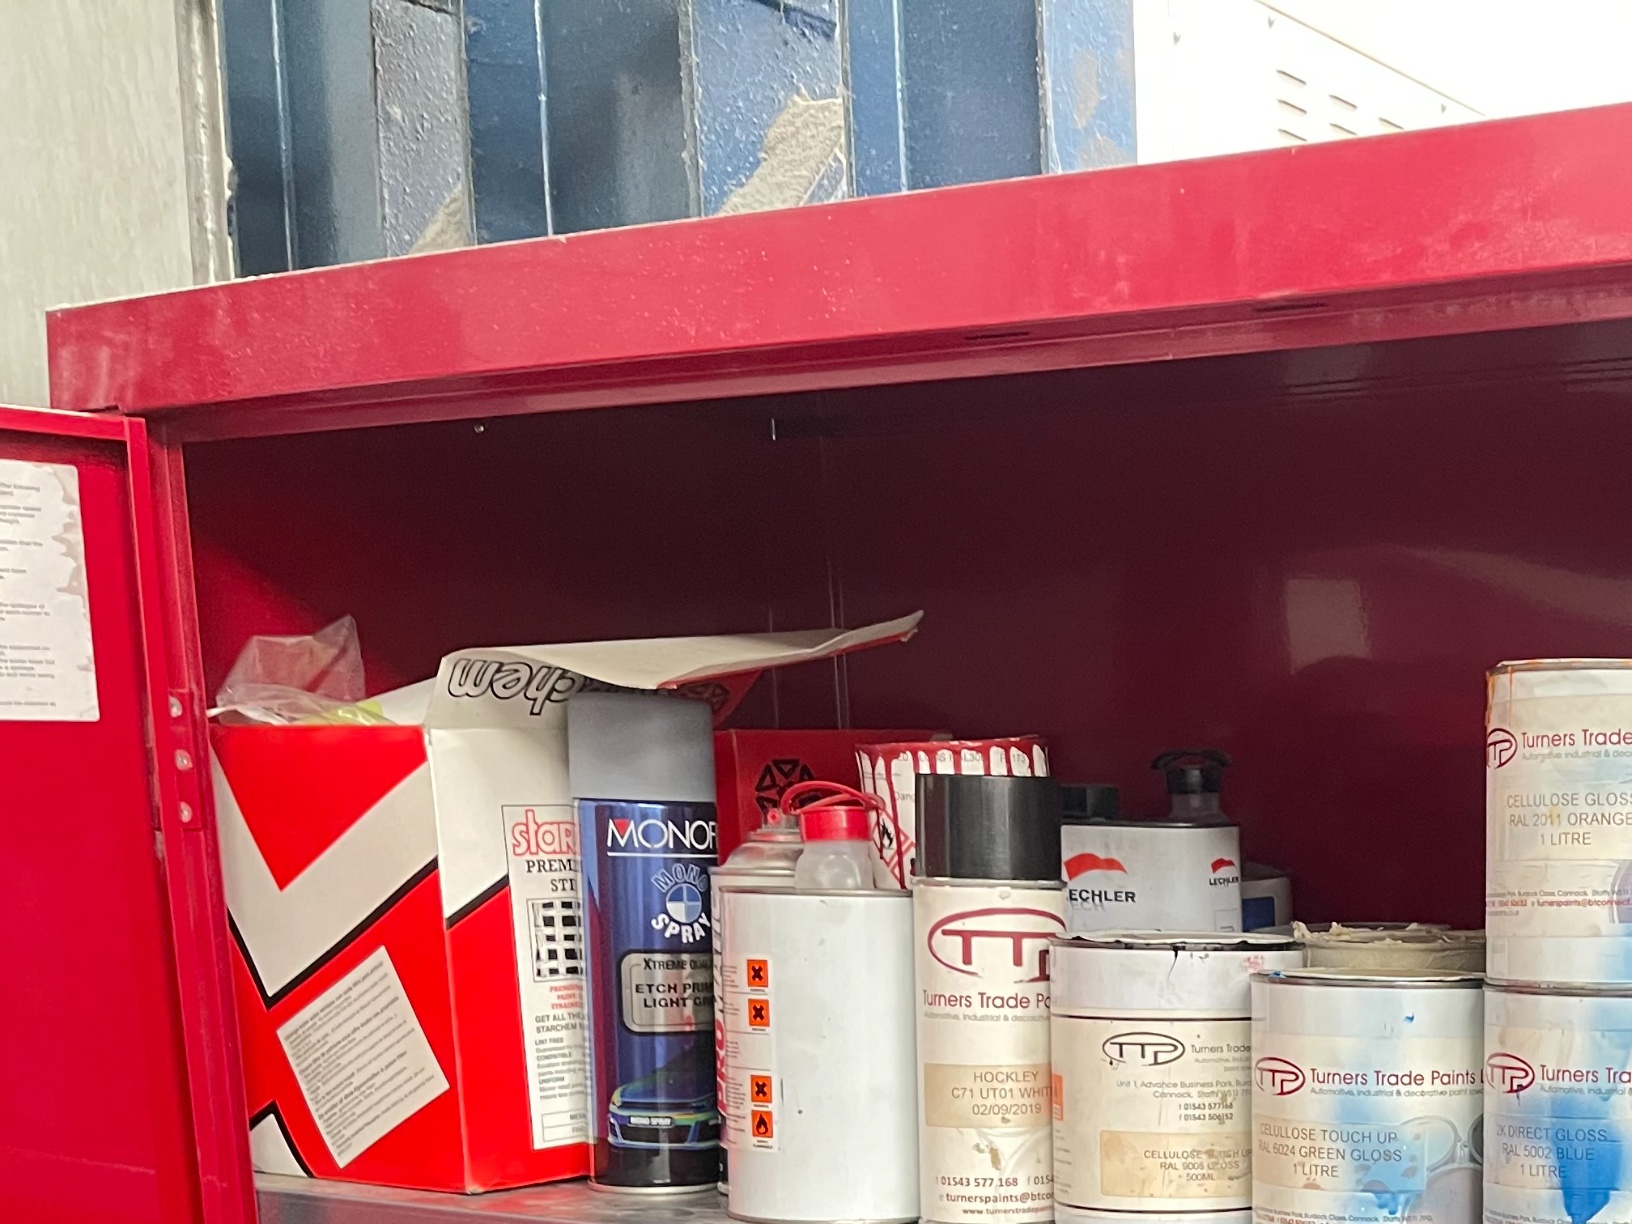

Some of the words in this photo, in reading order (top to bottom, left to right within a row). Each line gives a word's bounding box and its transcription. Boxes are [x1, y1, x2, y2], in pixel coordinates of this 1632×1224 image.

[1522, 732, 1575, 748] Turners
[1507, 793, 1579, 807] CELLULOSE
[1509, 814, 1530, 827] RAL
[1533, 814, 1562, 826] 2011
[1550, 832, 1591, 845] LITRE
[1209, 877, 1239, 886] LECHLER
[1066, 888, 1136, 903] ECHLER
[652, 911, 710, 944] SPRAY
[644, 957, 687, 970] XTREME
[636, 983, 676, 994] ETCH
[644, 997, 687, 1008] LIGHT
[924, 990, 972, 1009] Turners
[978, 992, 1030, 1009] Trade
[1191, 1045, 1224, 1053] Turners
[1226, 1044, 1251, 1052] Trade
[973, 1071, 1039, 1083] HOCKLEY
[1311, 1068, 1368, 1085] Turners
[1374, 1070, 1425, 1086] Trade
[1431, 1071, 1475, 1086] Paints
[1540, 1064, 1598, 1083] Turners
[951, 1088, 974, 1099] C71
[979, 1088, 1014, 1099] UT01
[972, 1104, 1042, 1116] 02/09/2019
[1321, 1129, 1372, 1144] TOUCH
[1377, 1132, 1397, 1144] UP
[1508, 1124, 1549, 1140] DIRECT
[1556, 1129, 1608, 1141] GLOSS
[1144, 1149, 1202, 1159] CELLULOSE
[1273, 1144, 1295, 1156] 6024
[1300, 1146, 1345, 1160] GREEN
[1351, 1149, 1402, 1162] GLOSS
[1502, 1142, 1520, 1156] RAL
[1524, 1146, 1551, 1159] 5002
[1556, 1148, 1594, 1161] BLUE
[1186, 1173, 1216, 1181] 500ML
[1302, 1164, 1339, 1177] LITRE
[1529, 1164, 1566, 1178] LITRE
[941, 1176, 969, 1187] 01543
[974, 1176, 994, 1187] 577
[998, 1177, 1018, 1187] 168
